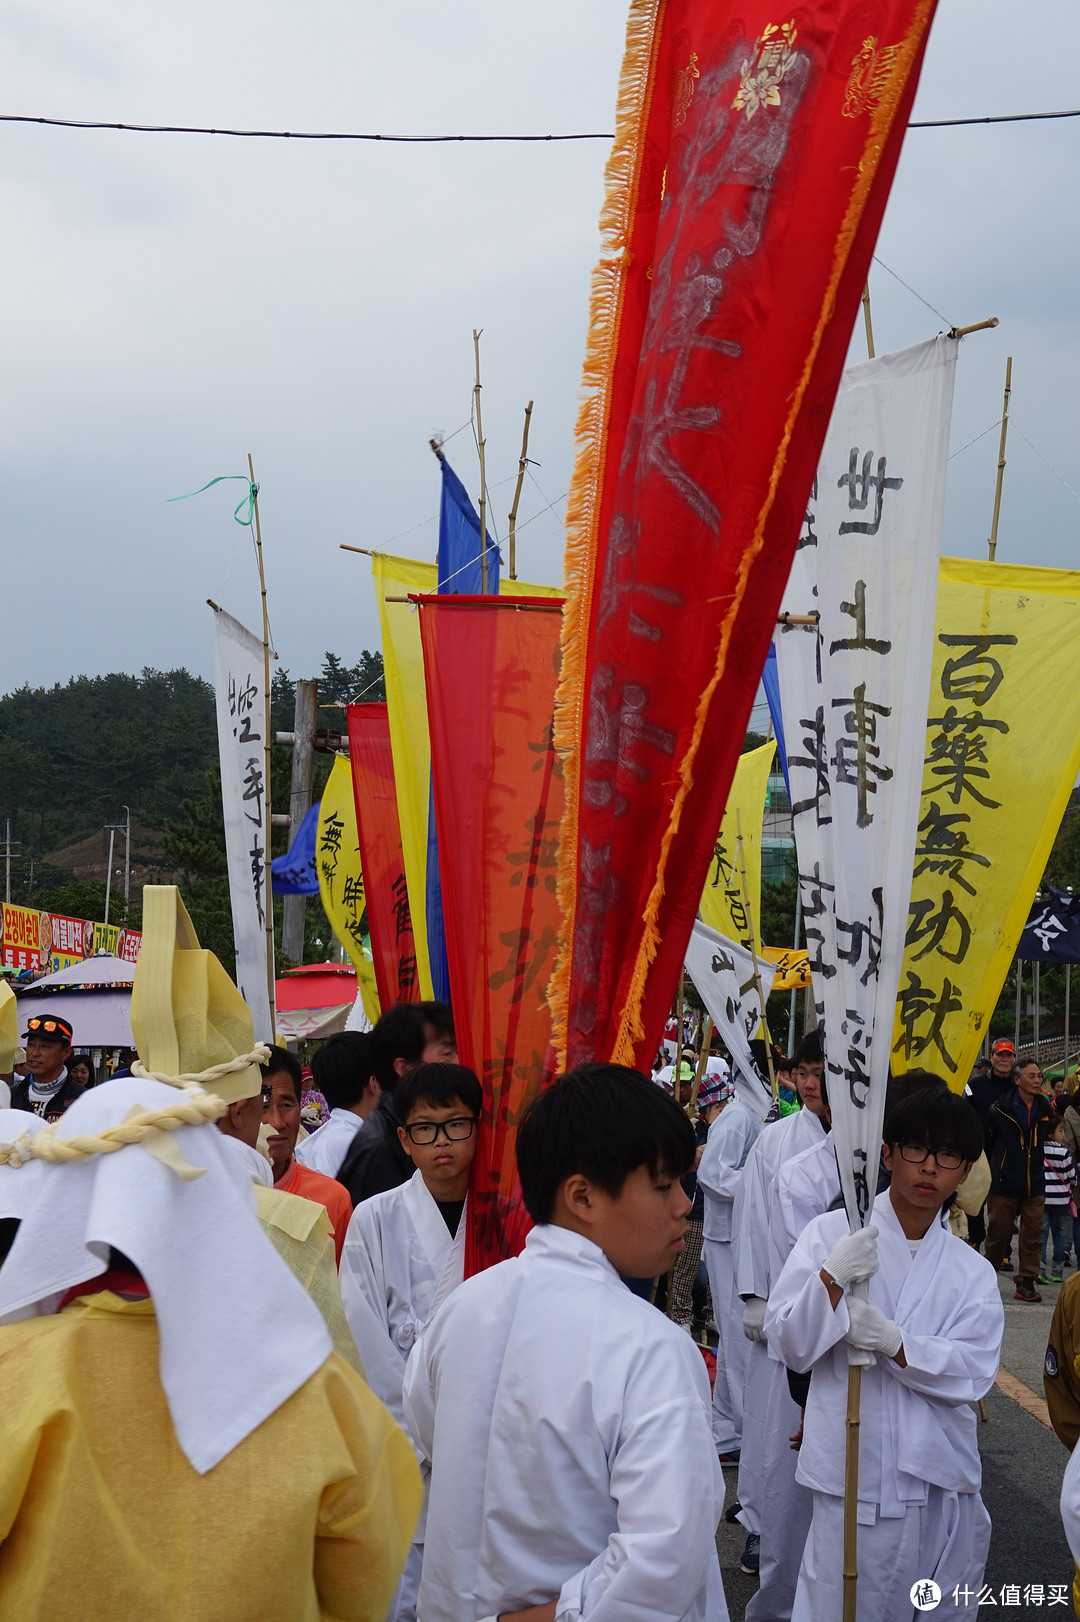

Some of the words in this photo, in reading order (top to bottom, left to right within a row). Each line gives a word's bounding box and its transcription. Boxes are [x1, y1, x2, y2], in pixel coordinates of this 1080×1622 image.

[893, 634, 1019, 1075] 百藥無功就
[5, 908, 39, 947] 오징어순대
[52, 917, 82, 953] 해물파전
